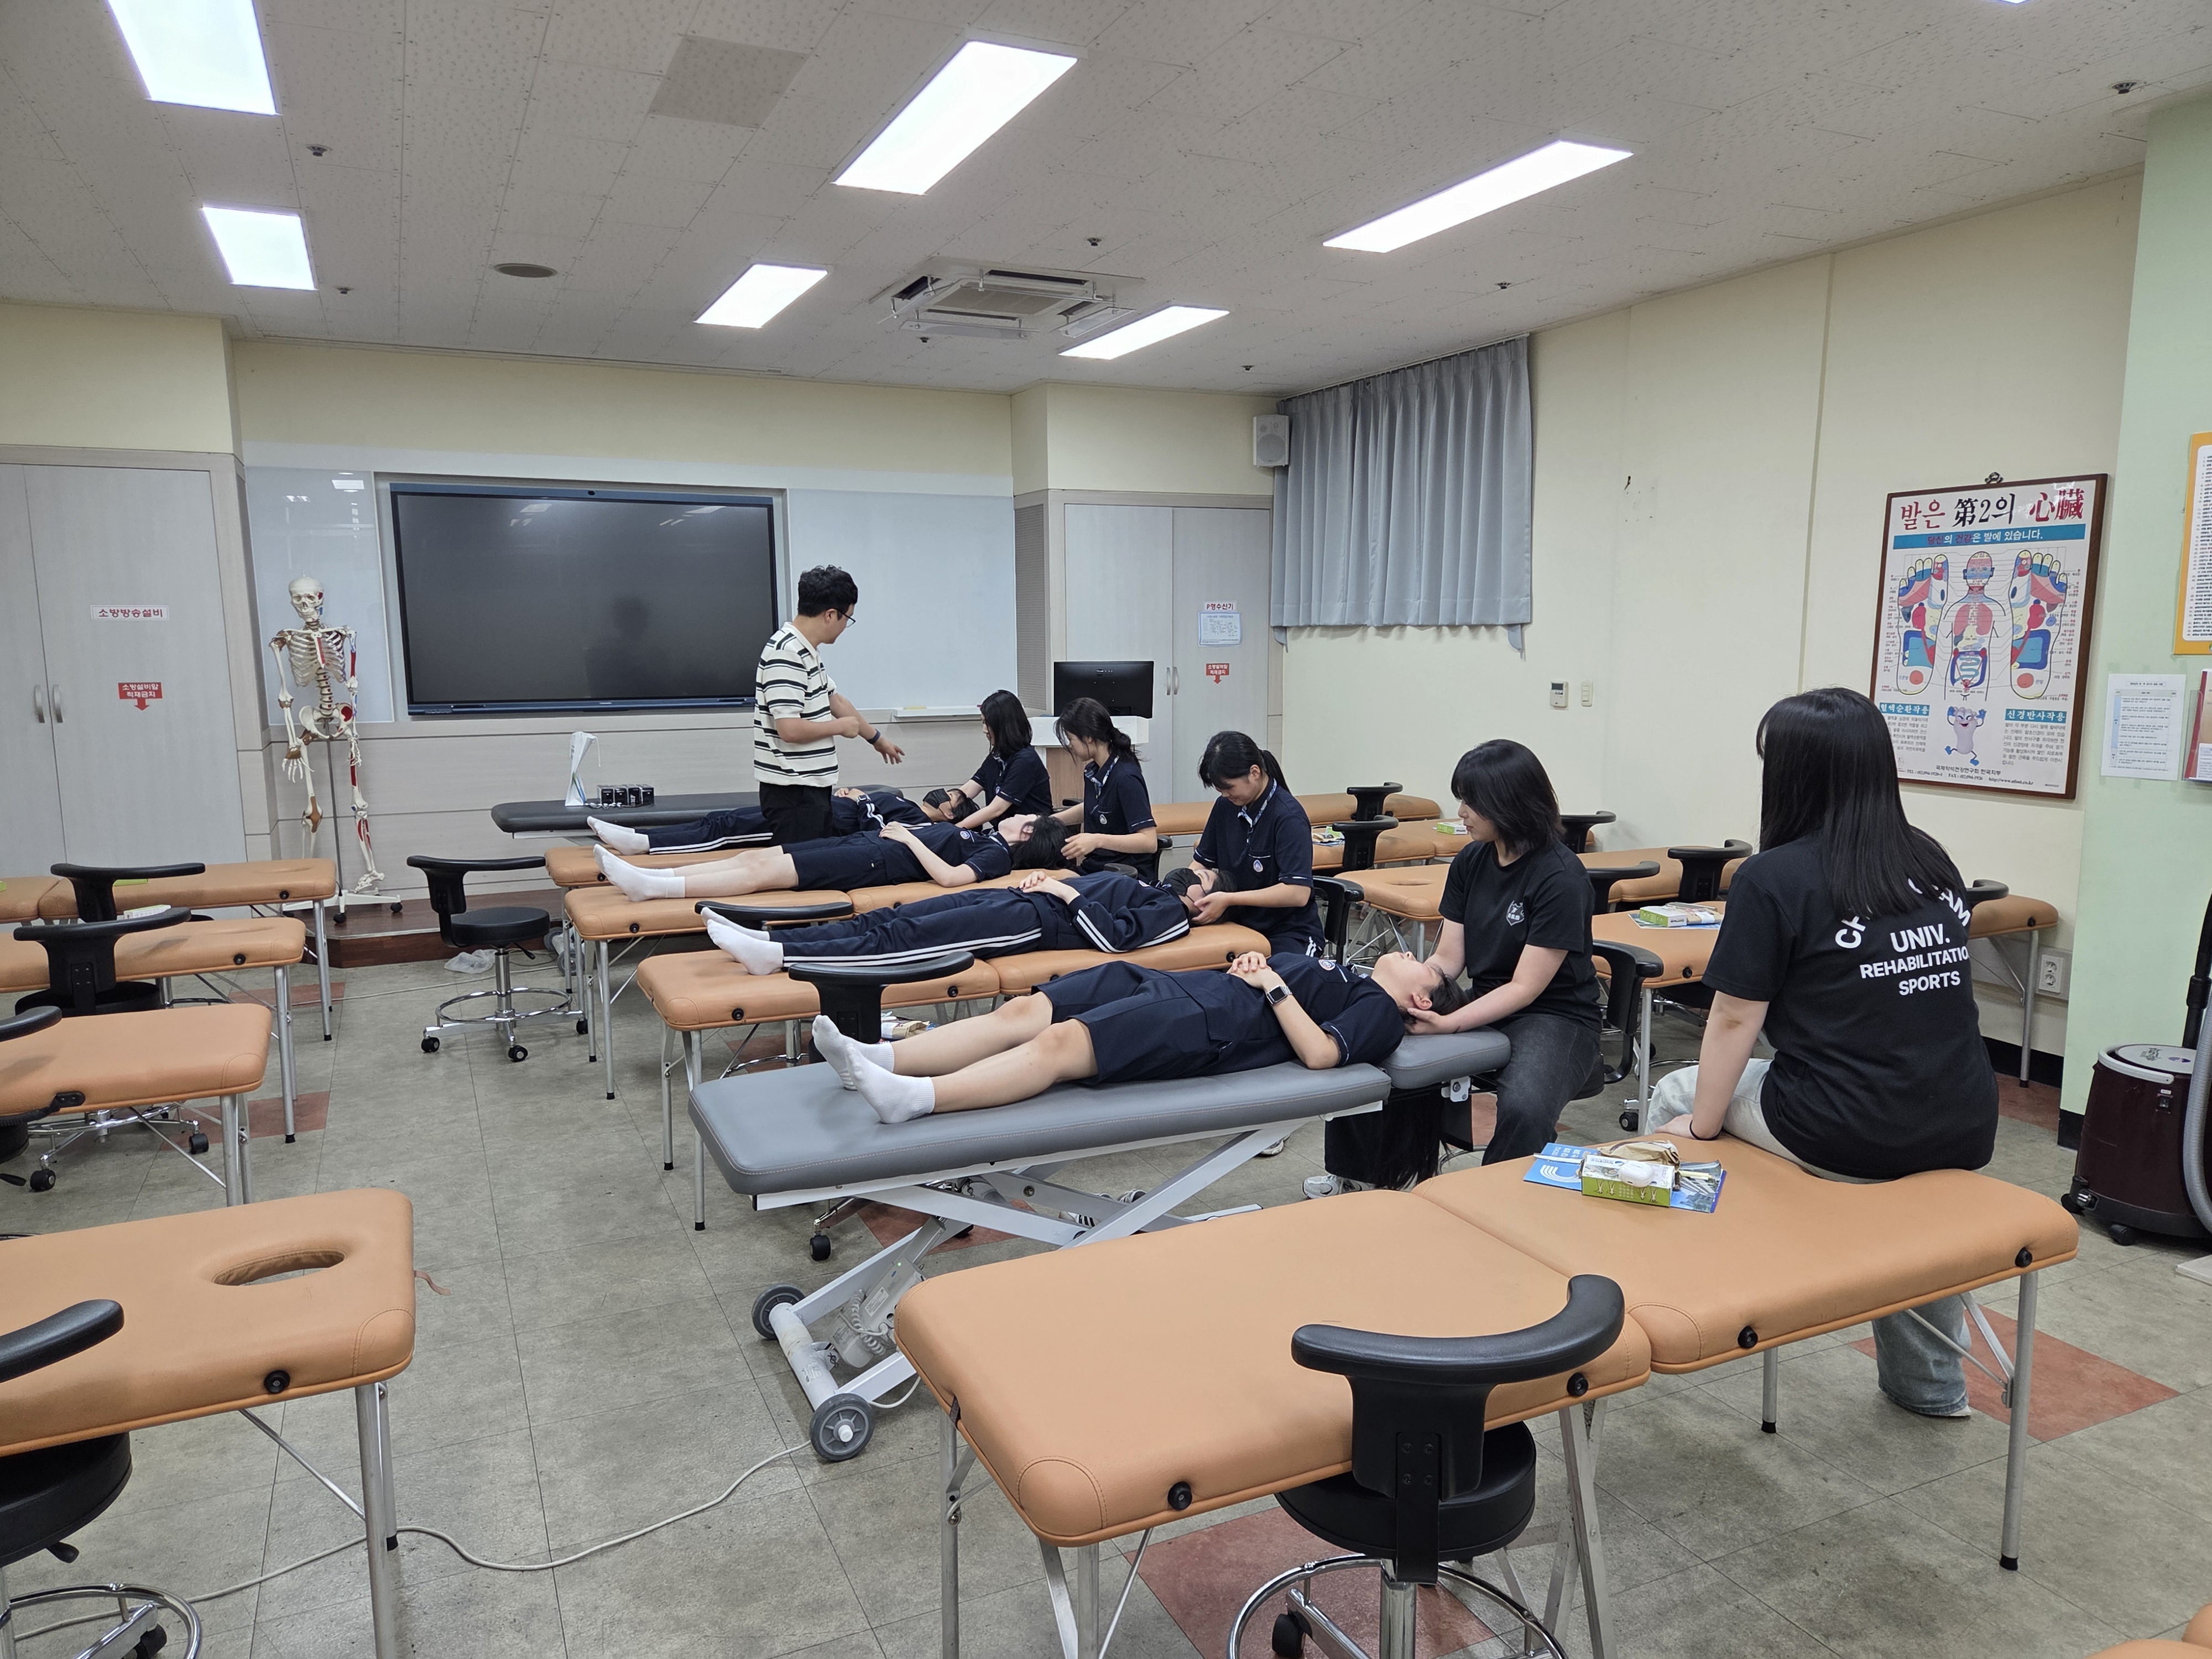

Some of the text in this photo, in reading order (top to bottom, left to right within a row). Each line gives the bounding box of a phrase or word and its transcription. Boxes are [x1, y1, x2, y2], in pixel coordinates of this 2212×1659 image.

[1901, 499, 1945, 530] 발은
[1952, 493, 2016, 527] 第2의
[1928, 530, 2043, 545] 당신의 건강은 발에 있습니다.
[98, 608, 163, 618] 소방방송설비
[2007, 710, 2065, 722] 신경반사작용
[1890, 924, 1950, 952] UNIV.
[1860, 946, 1969, 978] REHABILITATIO
[1898, 971, 1960, 995] SPORTS
